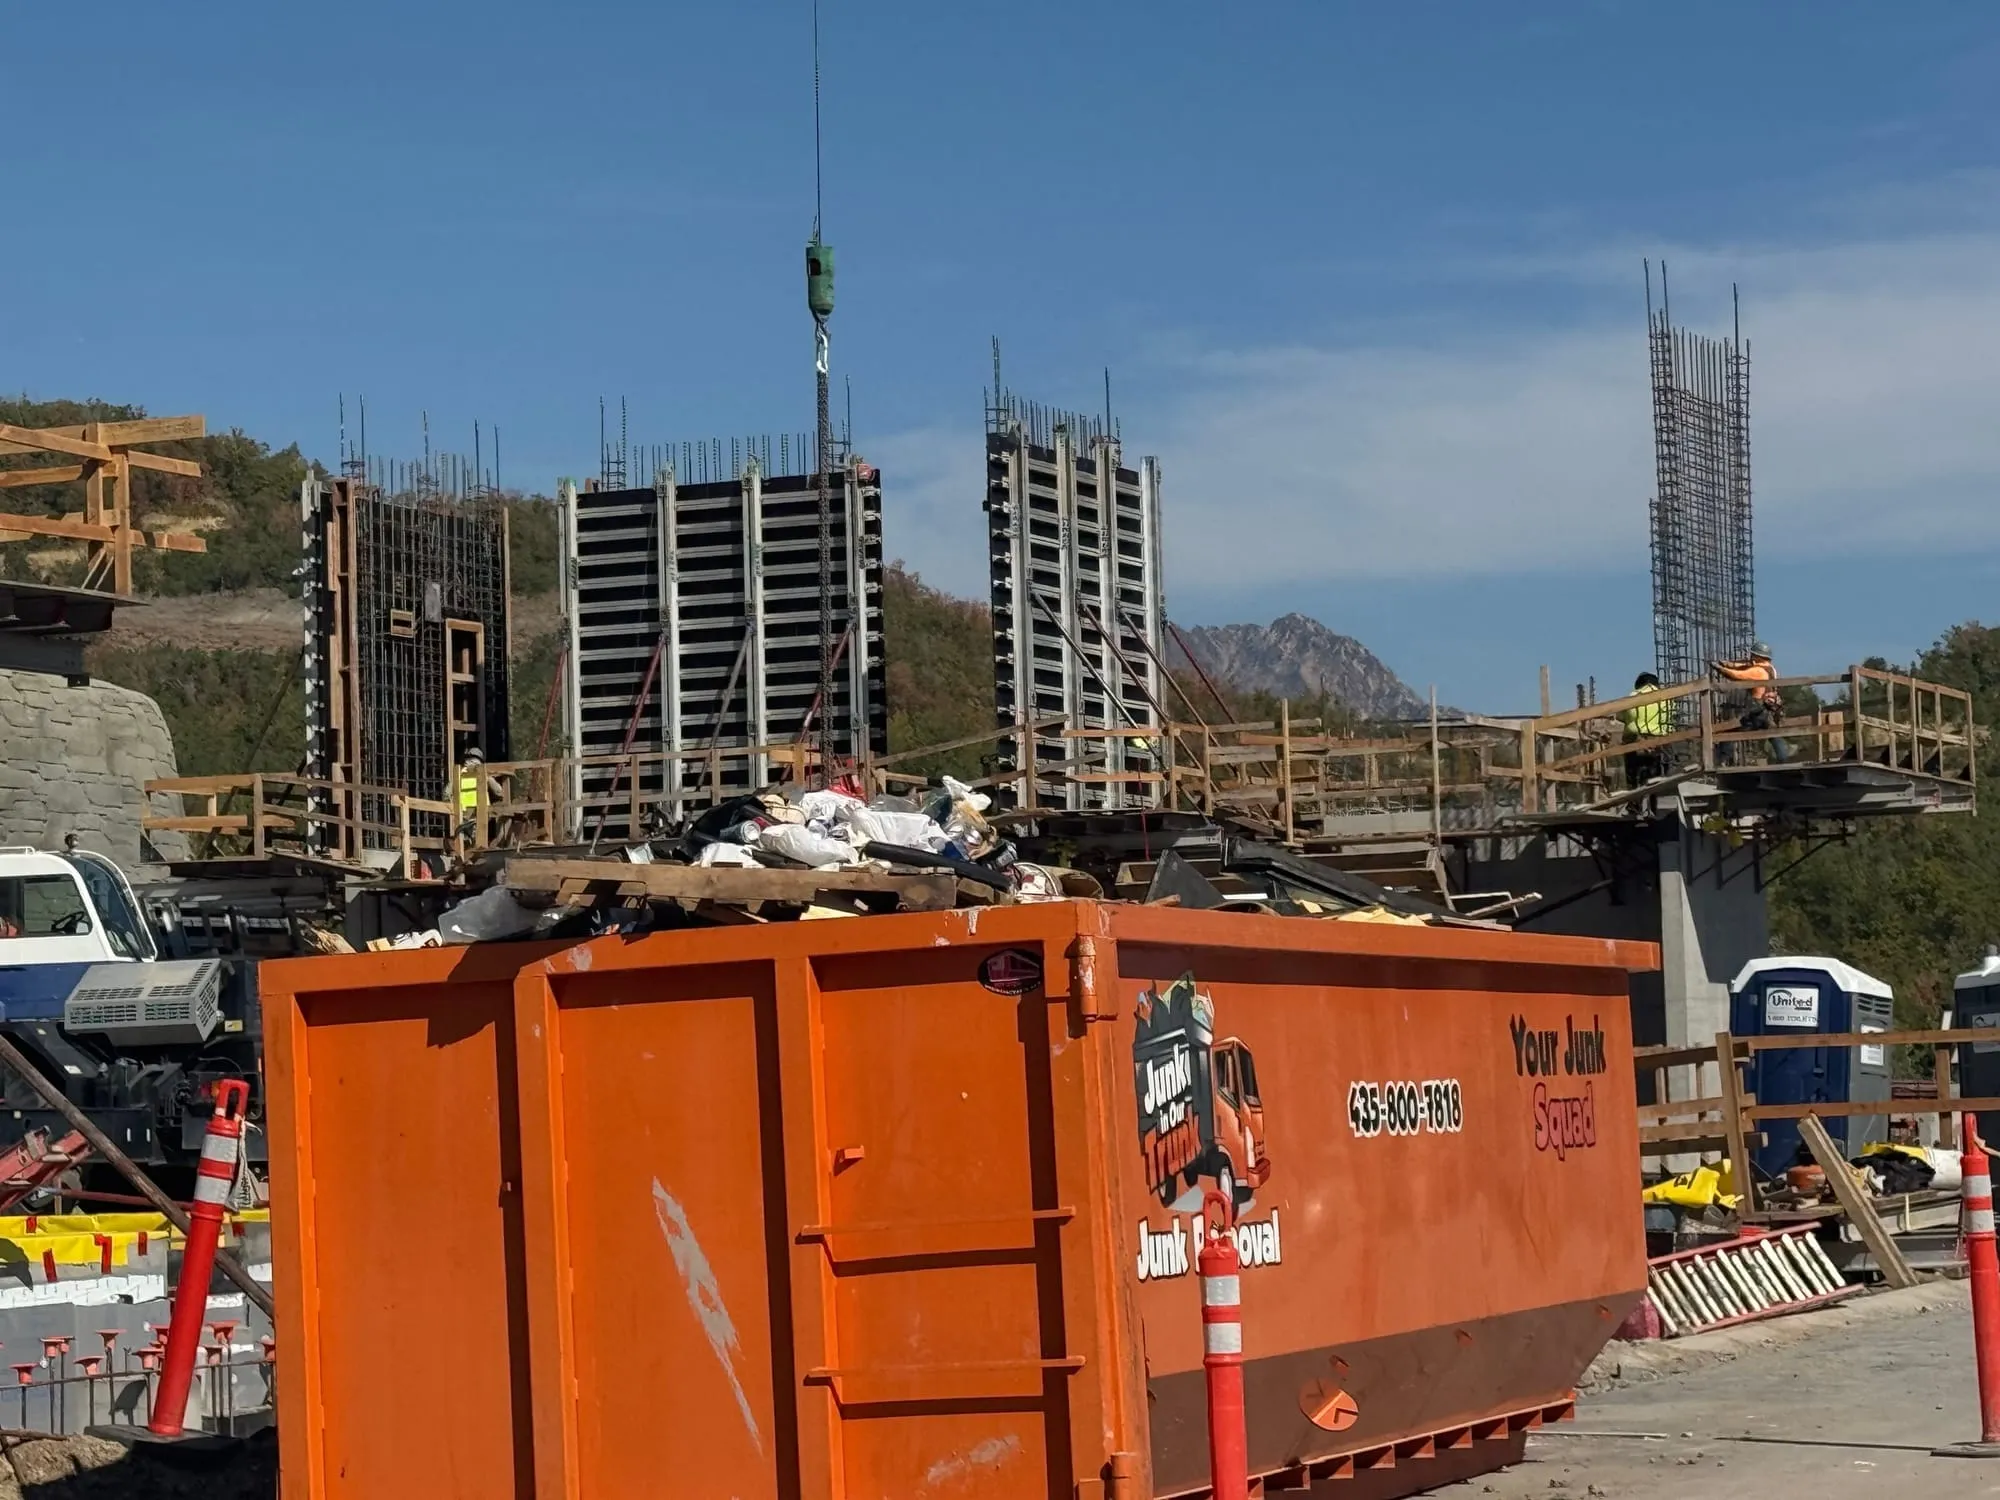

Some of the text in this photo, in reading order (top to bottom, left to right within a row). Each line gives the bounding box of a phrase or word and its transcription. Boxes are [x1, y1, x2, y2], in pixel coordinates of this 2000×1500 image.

[1509, 1013, 1607, 1077] Your Junk
[1144, 1043, 1188, 1115] Junk
[1348, 1079, 1464, 1137] 435-800-7818
[1144, 1104, 1202, 1195] Trunk
[1159, 1109, 1169, 1135] in
[1533, 1081, 1597, 1161] Squad
[1137, 1215, 1189, 1282] Junk
